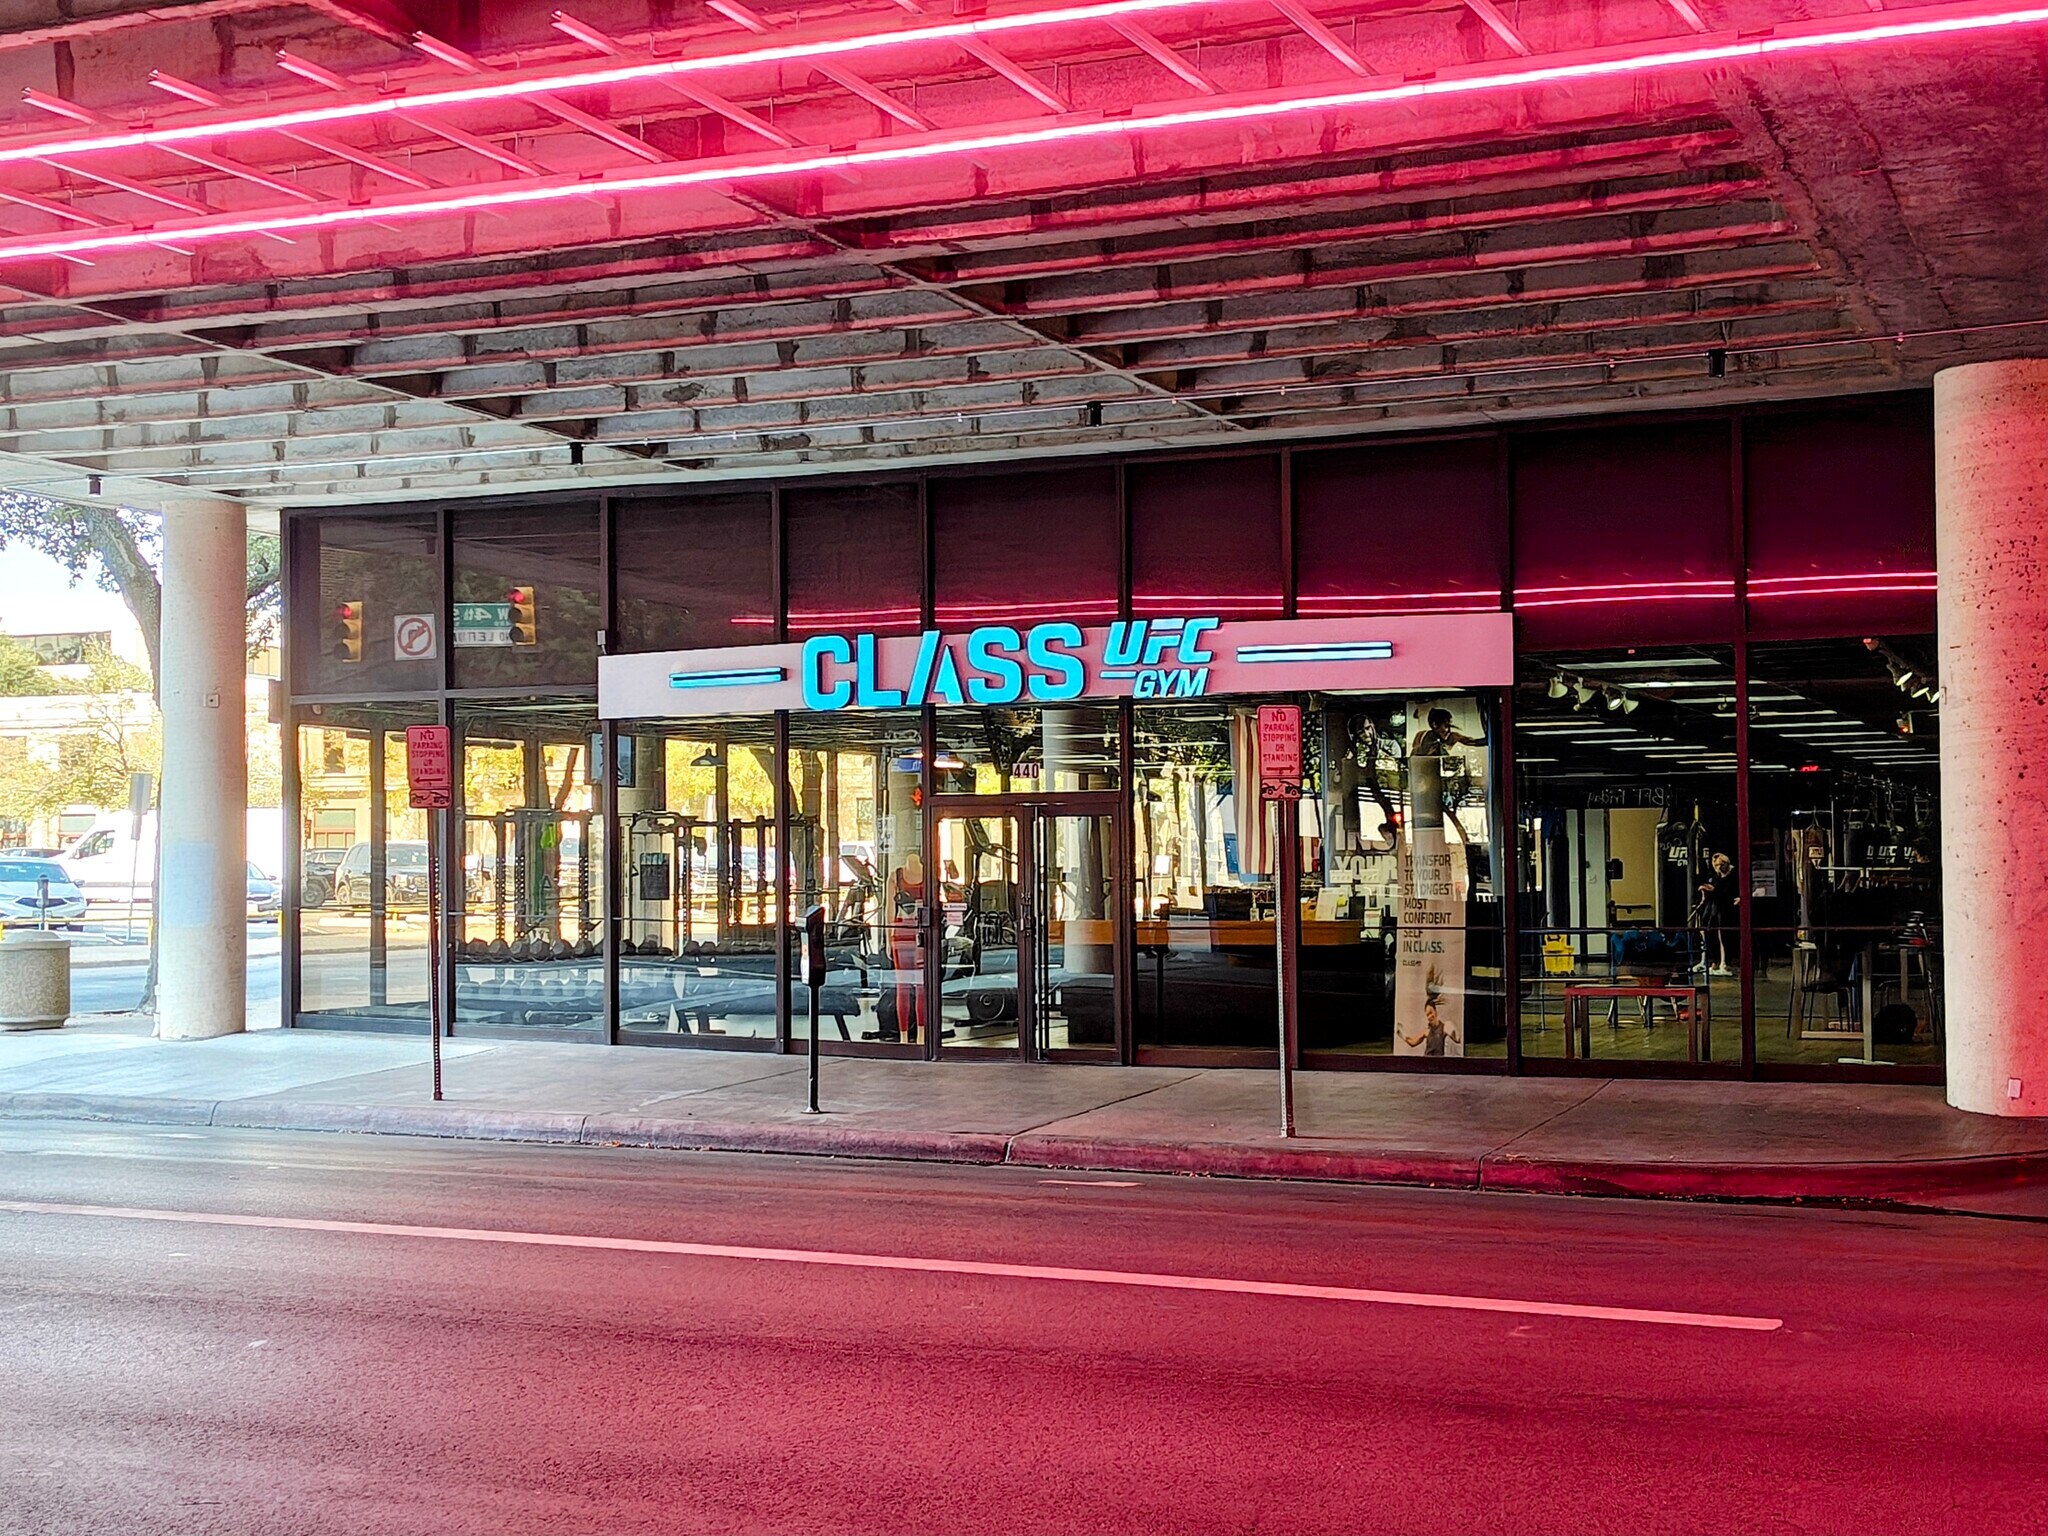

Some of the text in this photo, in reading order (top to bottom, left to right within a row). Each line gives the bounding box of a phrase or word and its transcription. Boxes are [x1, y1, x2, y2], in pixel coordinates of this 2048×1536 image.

[802, 617, 1219, 711] CLASS UFC
[1133, 668, 1208, 699] GYM
[1271, 710, 1287, 722] NO
[1264, 723, 1295, 732] PARKING
[420, 730, 435, 741] NO
[1263, 733, 1297, 742] STOPPING
[412, 741, 443, 749] PARKING
[1275, 743, 1285, 752] OR
[412, 750, 445, 758] STOPPING
[1263, 753, 1298, 762] STANDING
[423, 759, 433, 767] OR
[411, 767, 446, 776] STANDING
[1013, 763, 1039, 779] 440
[1404, 898, 1428, 910] MOST
[1404, 912, 1452, 924] CONFIDENT
[1402, 941, 1412, 953] IN
